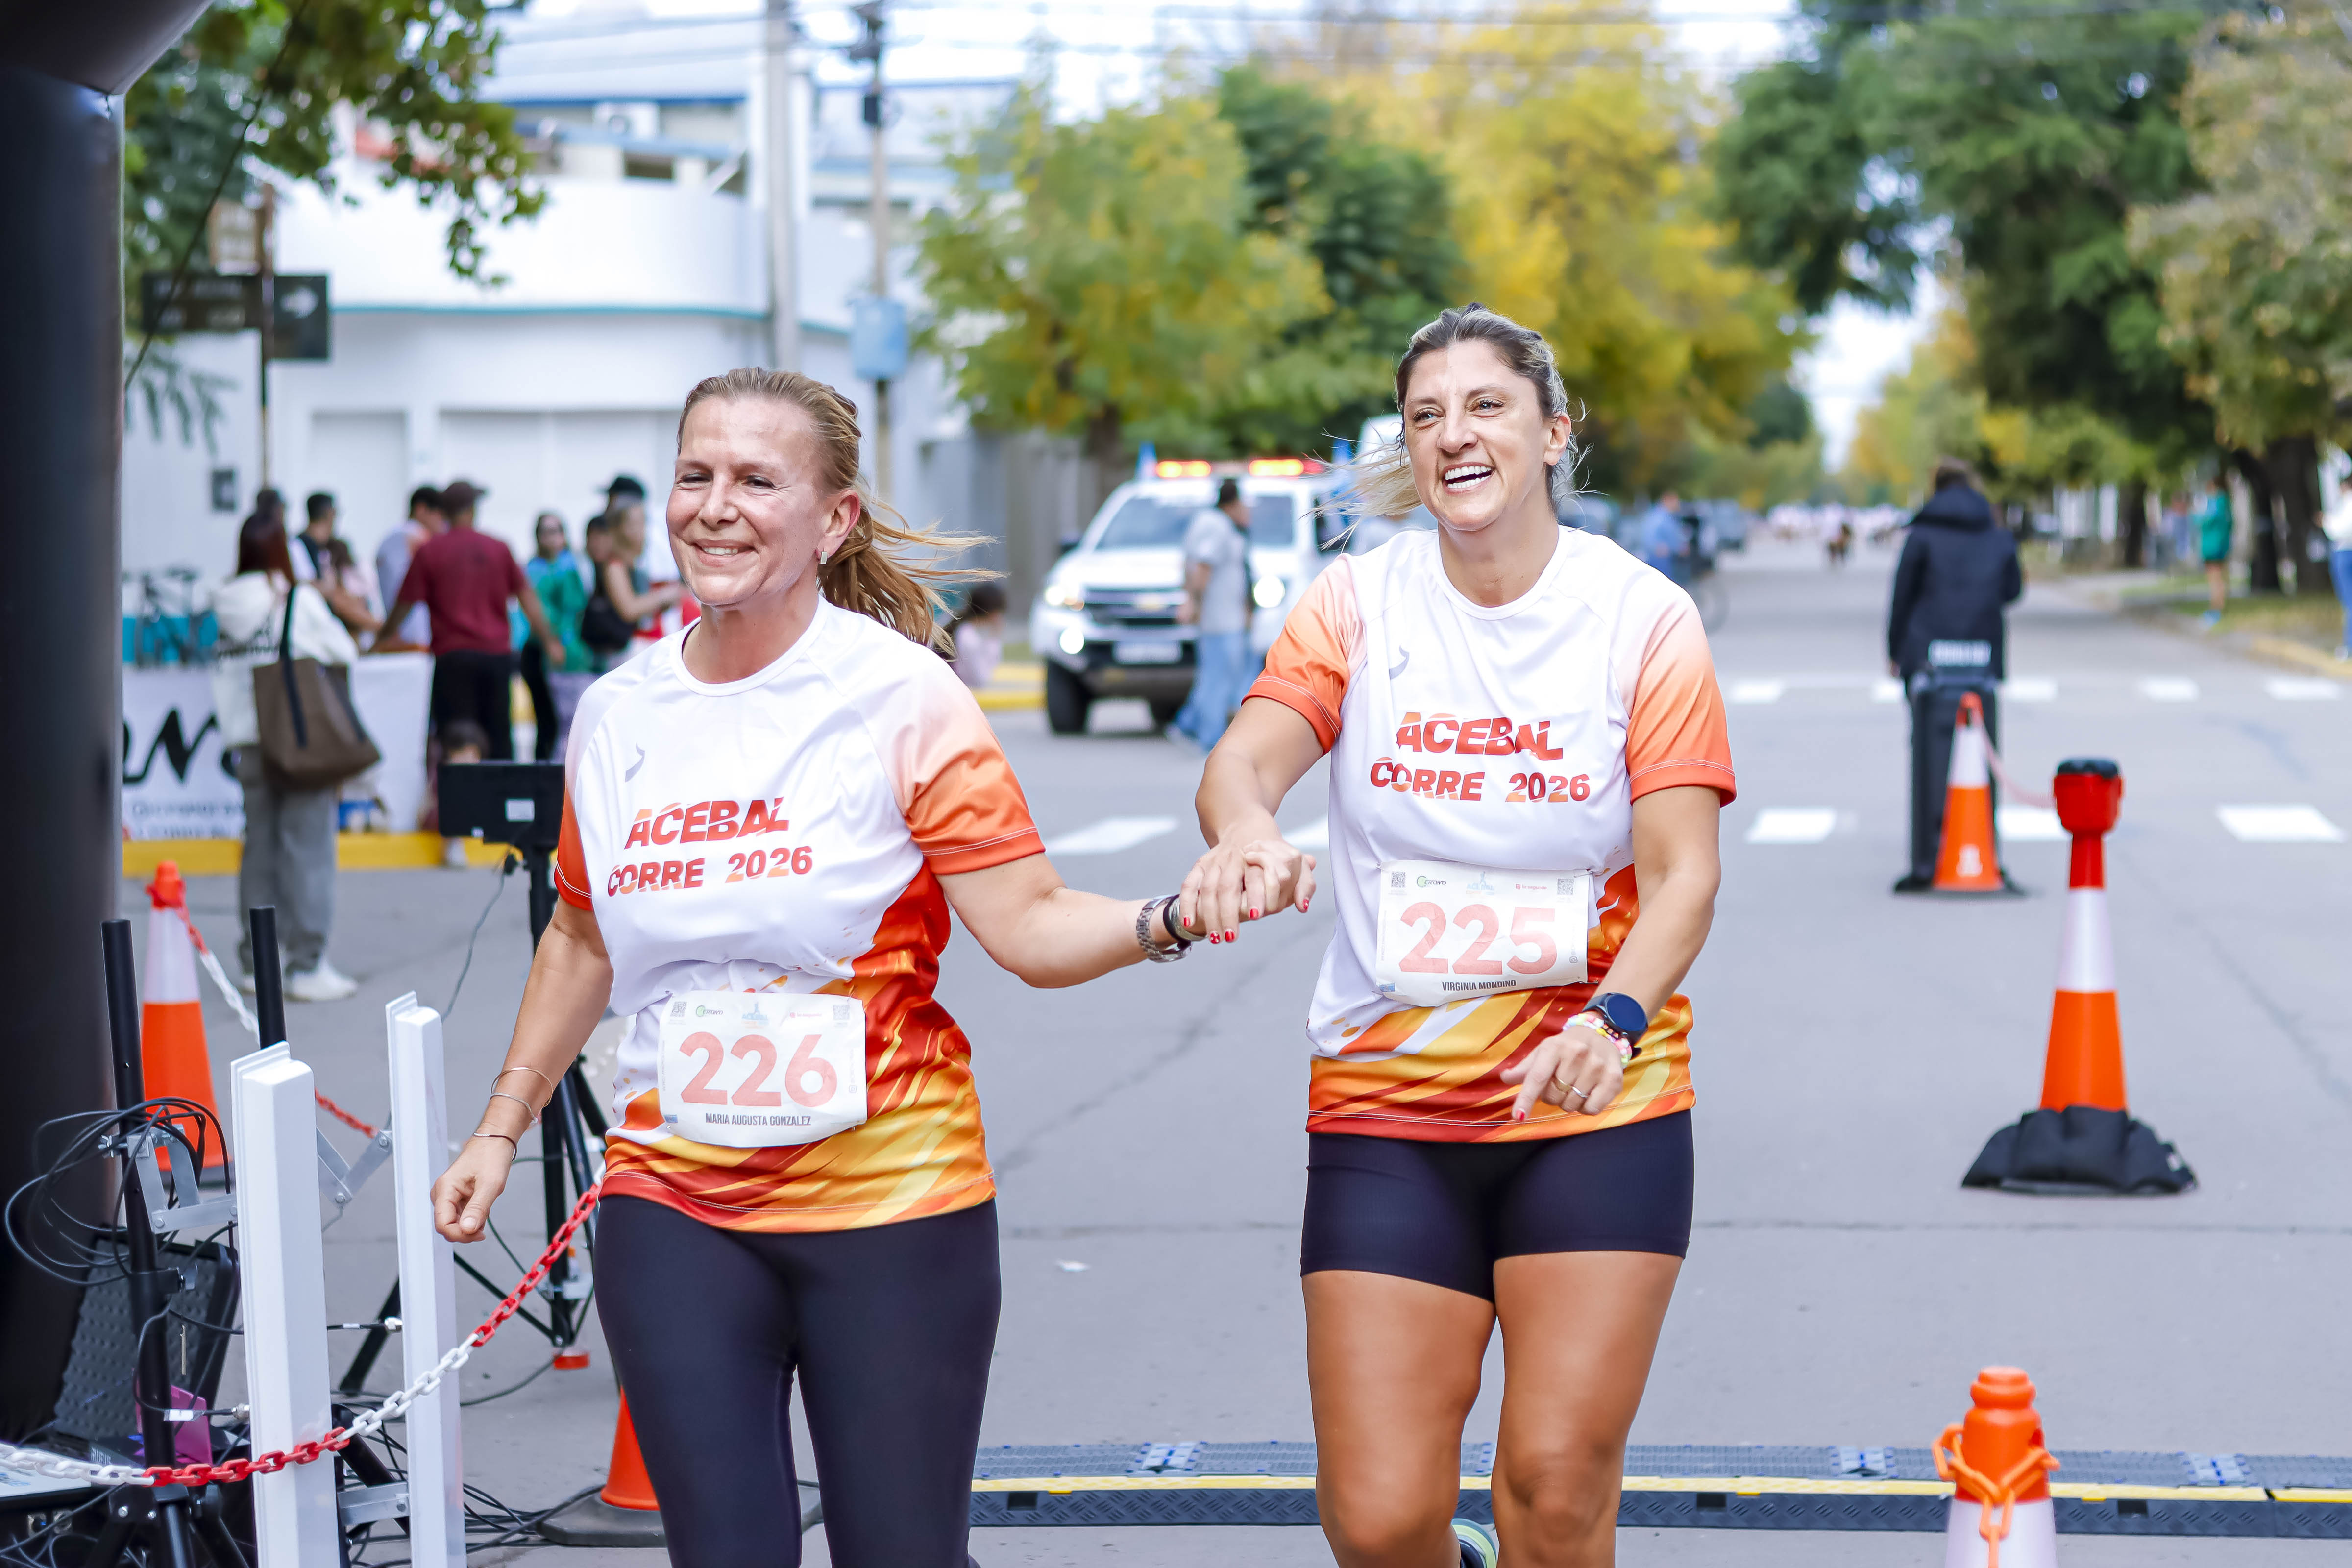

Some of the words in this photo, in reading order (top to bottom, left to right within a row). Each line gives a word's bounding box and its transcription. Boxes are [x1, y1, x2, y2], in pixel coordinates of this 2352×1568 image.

[1396, 711, 1563, 761] ACEBAL
[1370, 756, 1485, 801] CORRE
[1505, 772, 1590, 803] 2026
[624, 796, 789, 850] ACEBAL
[607, 858, 706, 897] CORRE
[725, 846, 813, 883] 2026
[1398, 901, 1557, 975] 225
[1442, 981, 1477, 991] VIRGINIA
[1479, 980, 1517, 990] MONDINO
[679, 1031, 838, 1107] 226
[706, 1113, 729, 1124] MARIA
[732, 1114, 767, 1126] AUGUSTA
[770, 1115, 811, 1126] GONZALEZ
